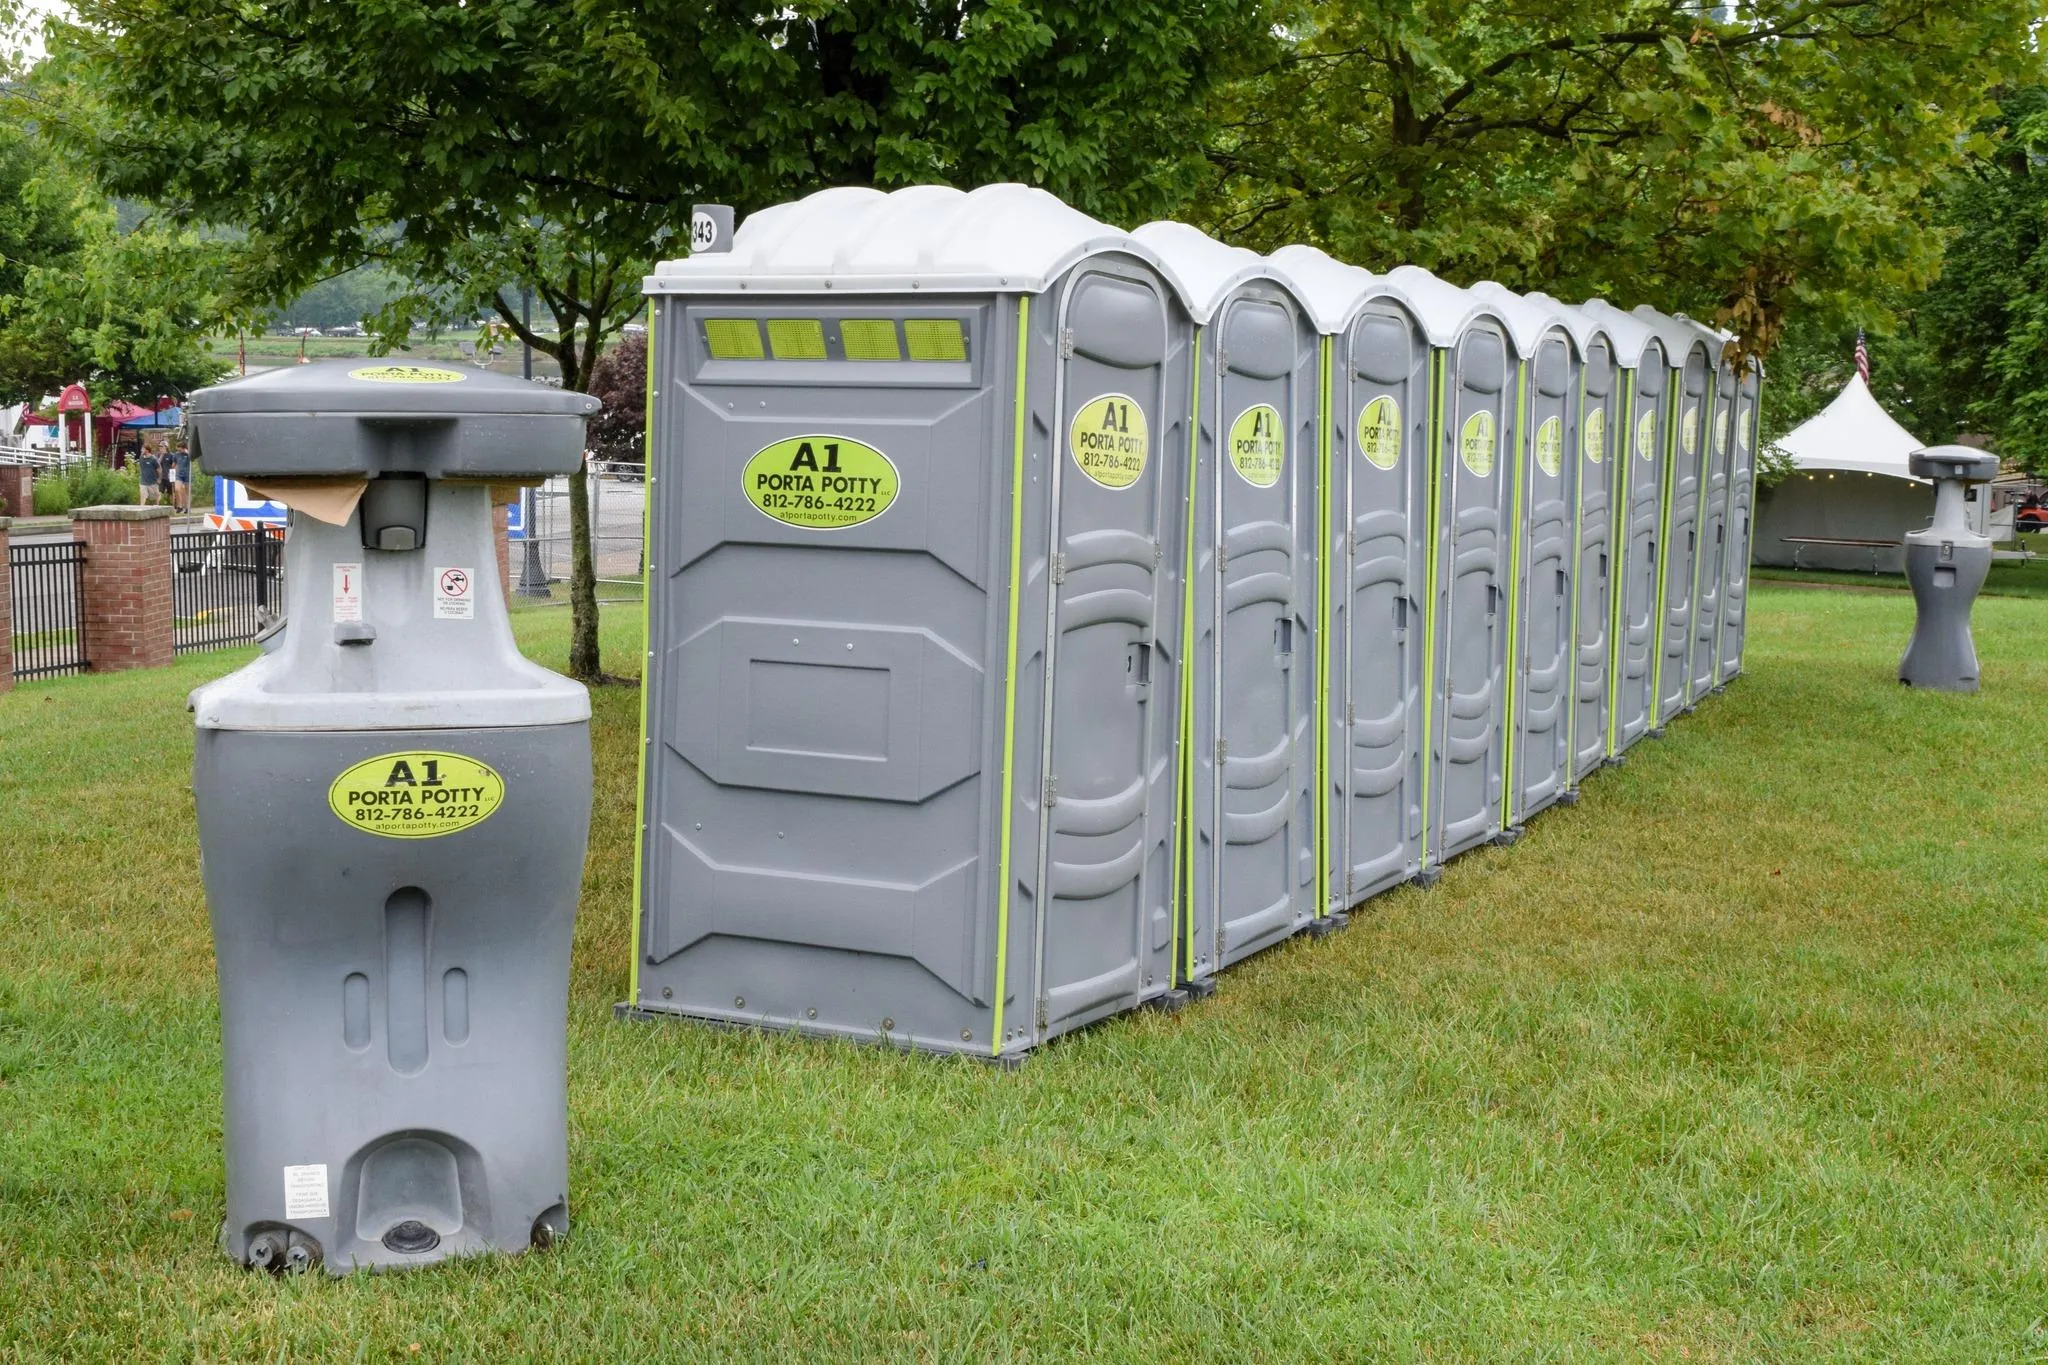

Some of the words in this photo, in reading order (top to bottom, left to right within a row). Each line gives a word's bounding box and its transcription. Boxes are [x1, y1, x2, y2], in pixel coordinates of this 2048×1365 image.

[1102, 402, 1128, 433] A1
[1253, 411, 1271, 438] A1
[1080, 432, 1115, 451] PORTA
[790, 442, 842, 473] A1
[1083, 452, 1141, 472] 812-786-4222
[757, 474, 814, 491] PORTA
[822, 476, 882, 494] POTTY
[763, 494, 875, 512] 812-786-4222
[780, 511, 857, 522] a1portapotty.com
[384, 760, 442, 787] A1
[349, 790, 413, 805] PORTA
[422, 787, 485, 804] POTTY
[356, 805, 479, 821] 812-786-4222
[376, 820, 460, 831] a1portapotty.com
